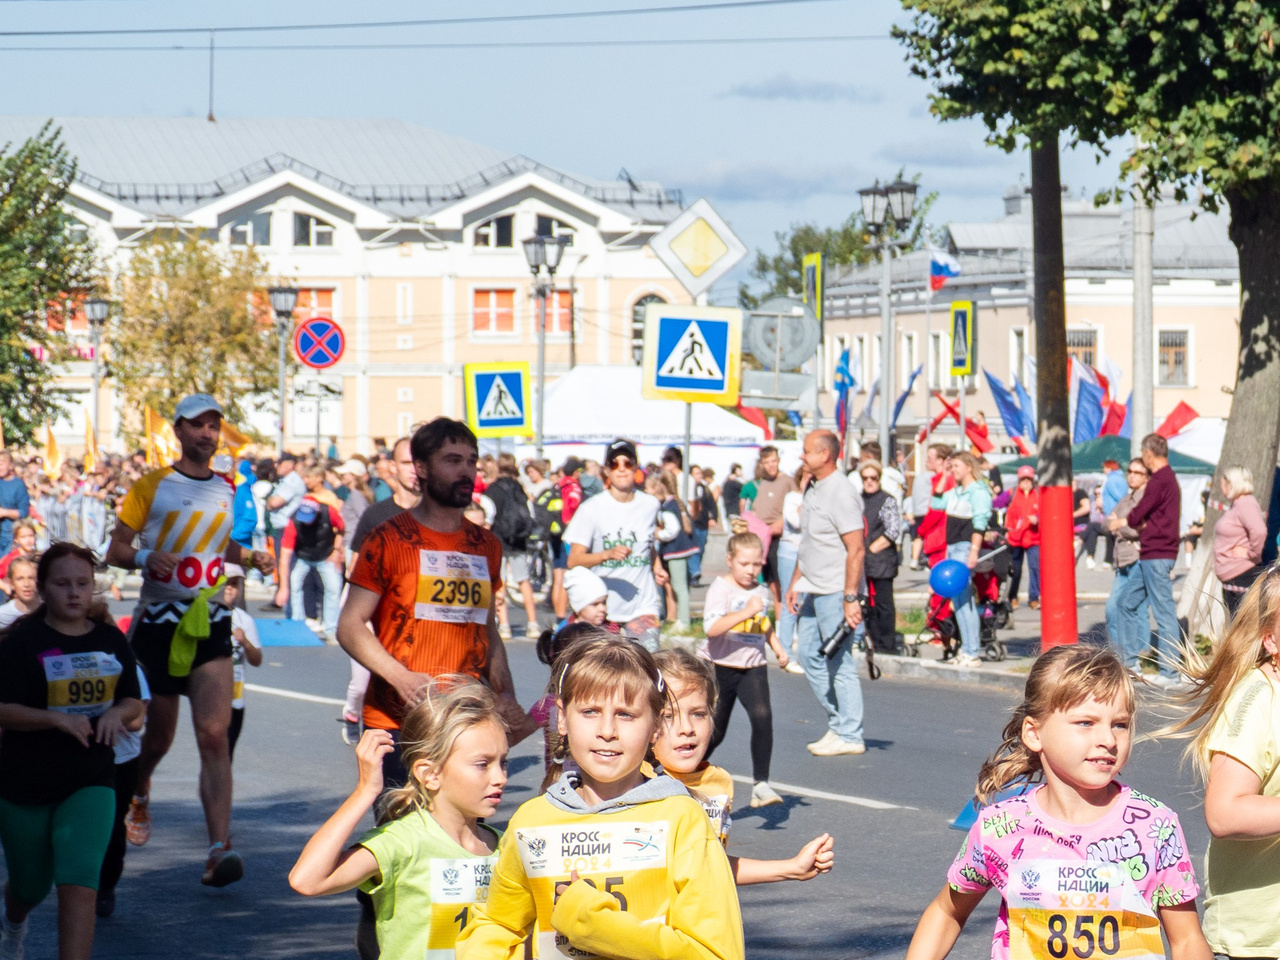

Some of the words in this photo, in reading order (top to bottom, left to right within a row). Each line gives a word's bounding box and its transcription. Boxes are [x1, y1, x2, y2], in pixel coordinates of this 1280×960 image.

[430, 579, 482, 605] 2396
[68, 679, 105, 704] 999
[983, 811, 1008, 829] BEST
[995, 819, 1025, 838] EVER
[1033, 825, 1053, 838] will
[561, 831, 600, 844] КРОСС
[1057, 837, 1076, 849] you
[561, 843, 612, 857] НАЦИИ
[562, 857, 612, 872] 2024
[1058, 867, 1098, 879] КРОСС
[1058, 880, 1109, 893] НАЦИИ
[1058, 894, 1110, 908] 2024
[1047, 914, 1120, 960] 850
